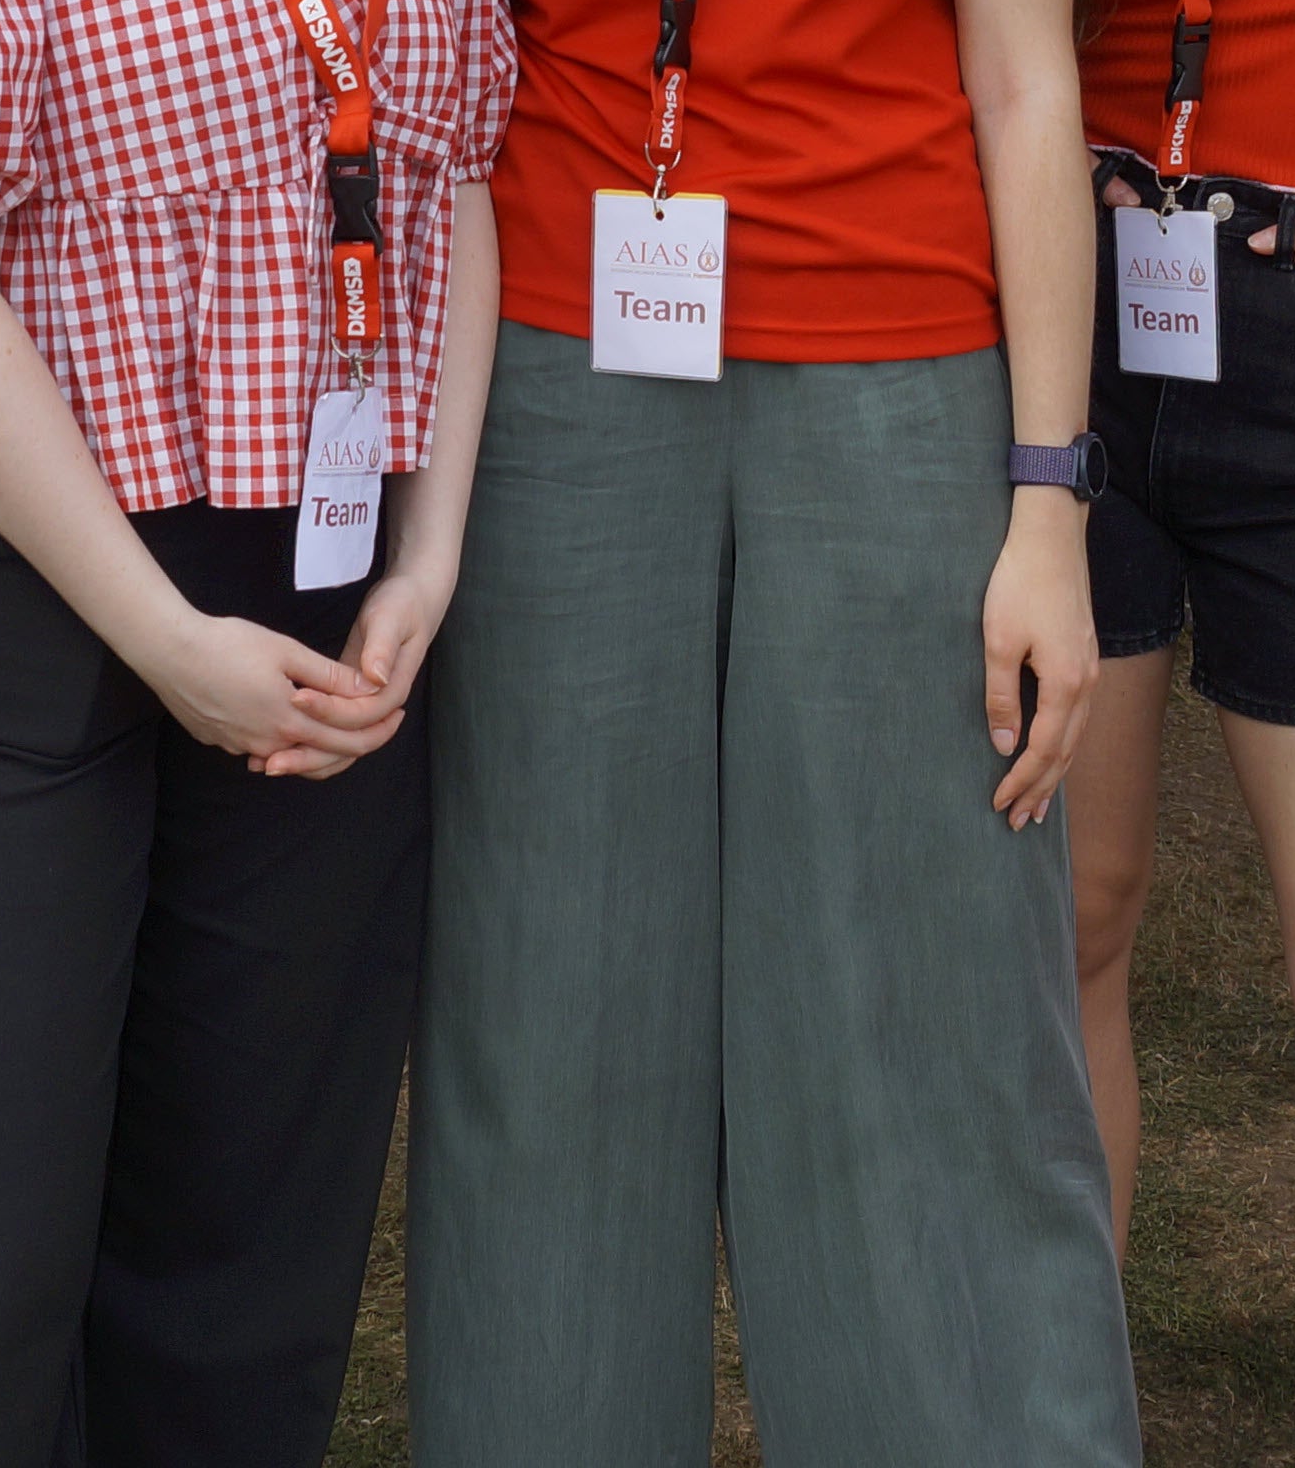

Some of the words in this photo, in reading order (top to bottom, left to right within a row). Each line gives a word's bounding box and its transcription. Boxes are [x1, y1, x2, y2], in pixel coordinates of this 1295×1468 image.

[306, 13, 359, 93] DKMS
[658, 88, 678, 149] DKMS
[1169, 113, 1191, 166] DKMS
[615, 239, 689, 267] AIAS
[1126, 257, 1183, 282] AIAS
[347, 276, 365, 337] DKMS
[613, 289, 707, 325] Team
[1128, 303, 1200, 334] Team
[317, 439, 365, 468] AIAS
[310, 497, 369, 528] Team
